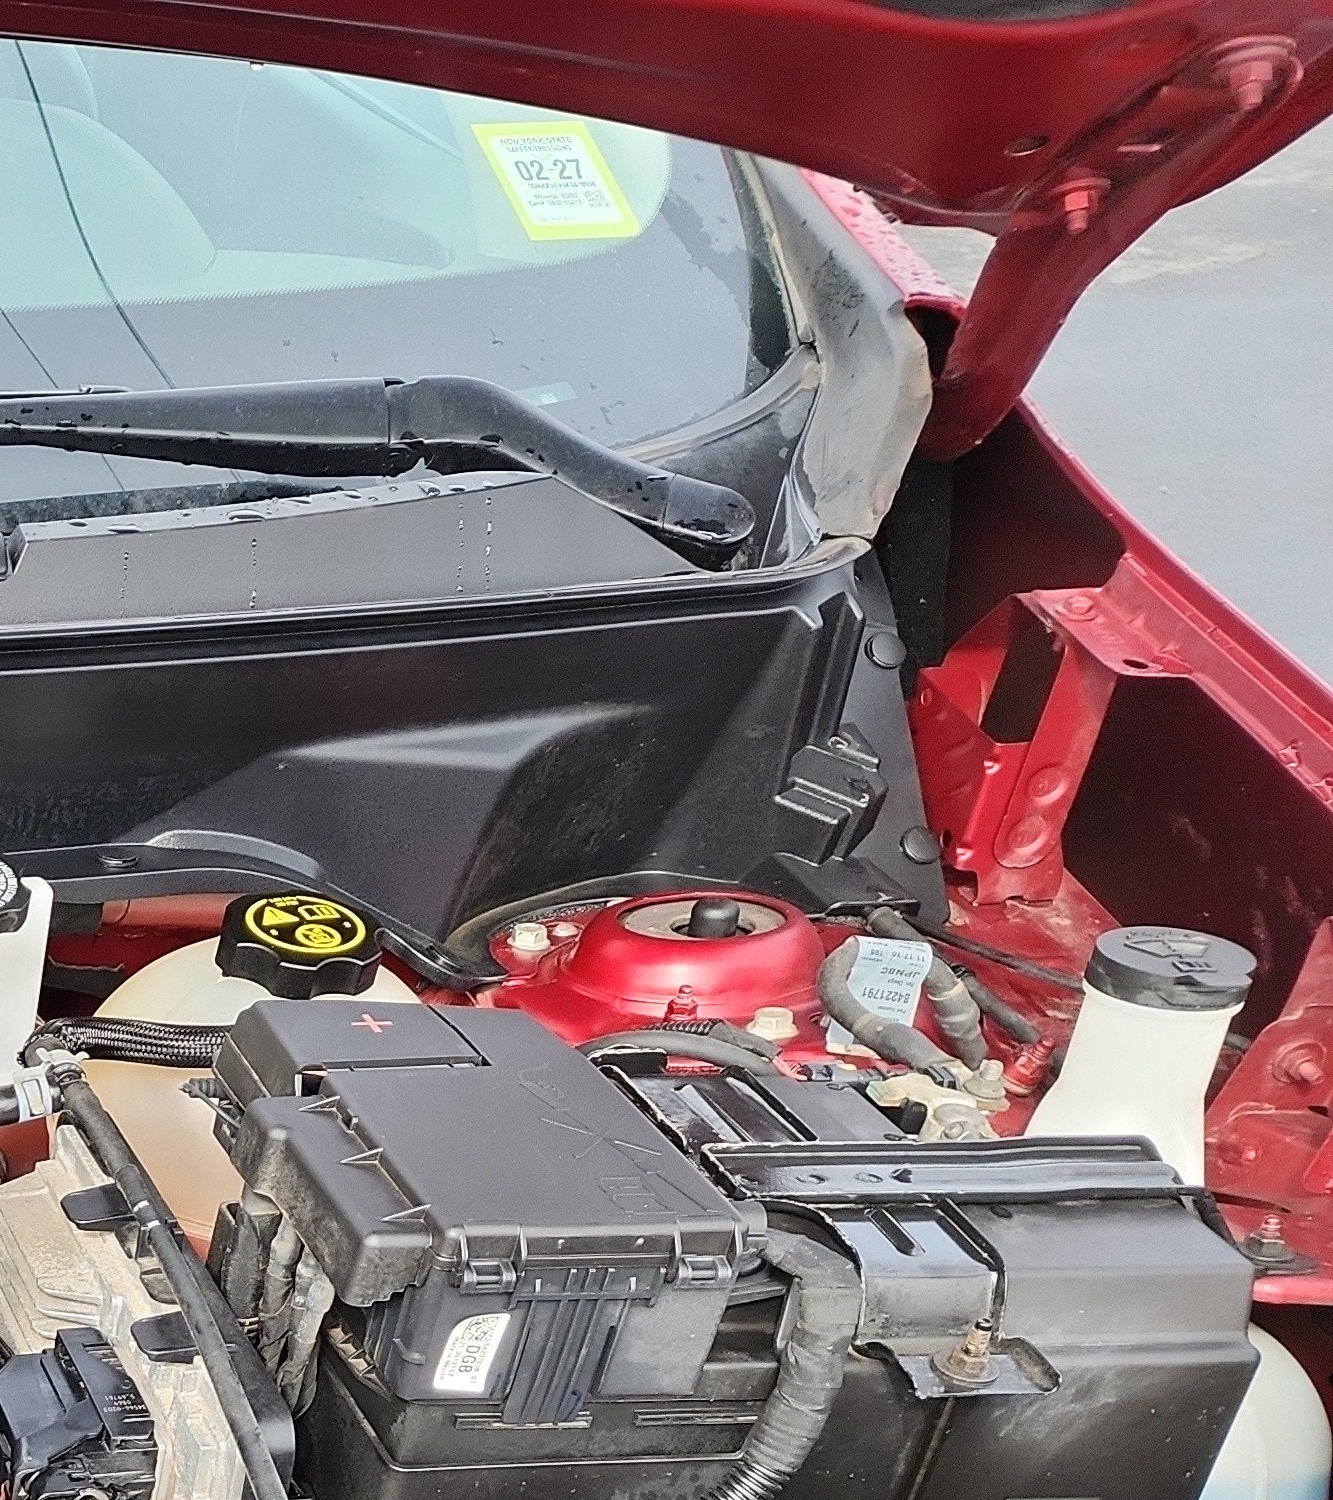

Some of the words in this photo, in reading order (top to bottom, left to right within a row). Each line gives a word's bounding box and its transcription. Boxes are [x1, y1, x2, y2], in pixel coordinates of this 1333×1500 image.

[514, 158, 583, 181] 02-27
[862, 987, 911, 1004] 84221791
[458, 1345, 481, 1373] DGB
